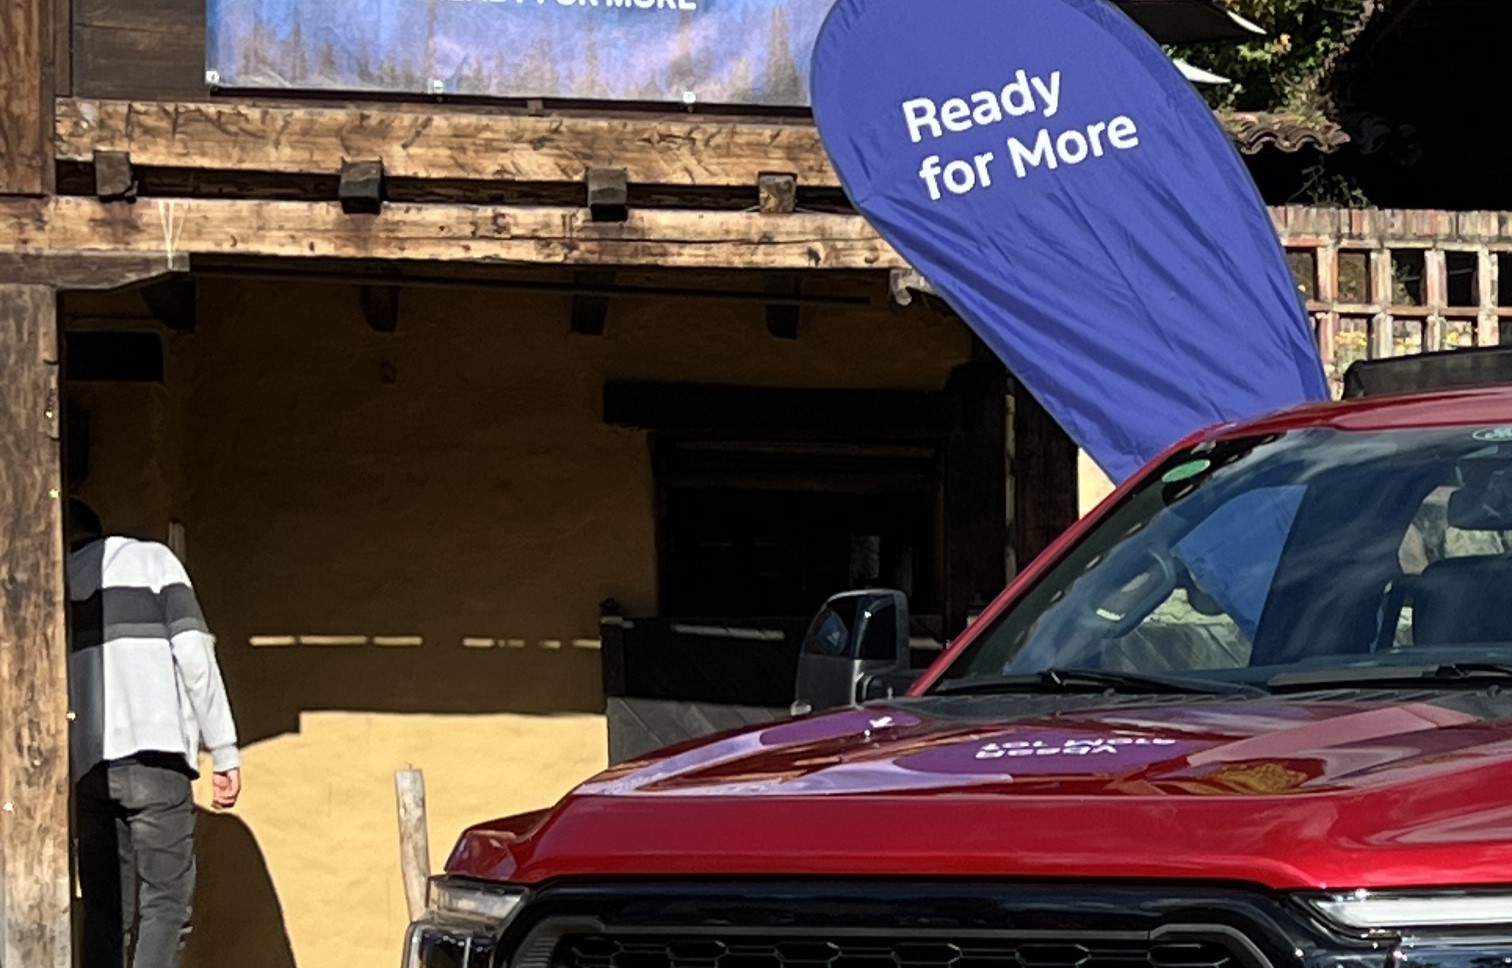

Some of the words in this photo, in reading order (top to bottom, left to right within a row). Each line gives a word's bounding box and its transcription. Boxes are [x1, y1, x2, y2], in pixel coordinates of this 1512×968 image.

[902, 69, 1060, 142] Ready
[919, 152, 994, 200] for
[1007, 115, 1139, 178] More
